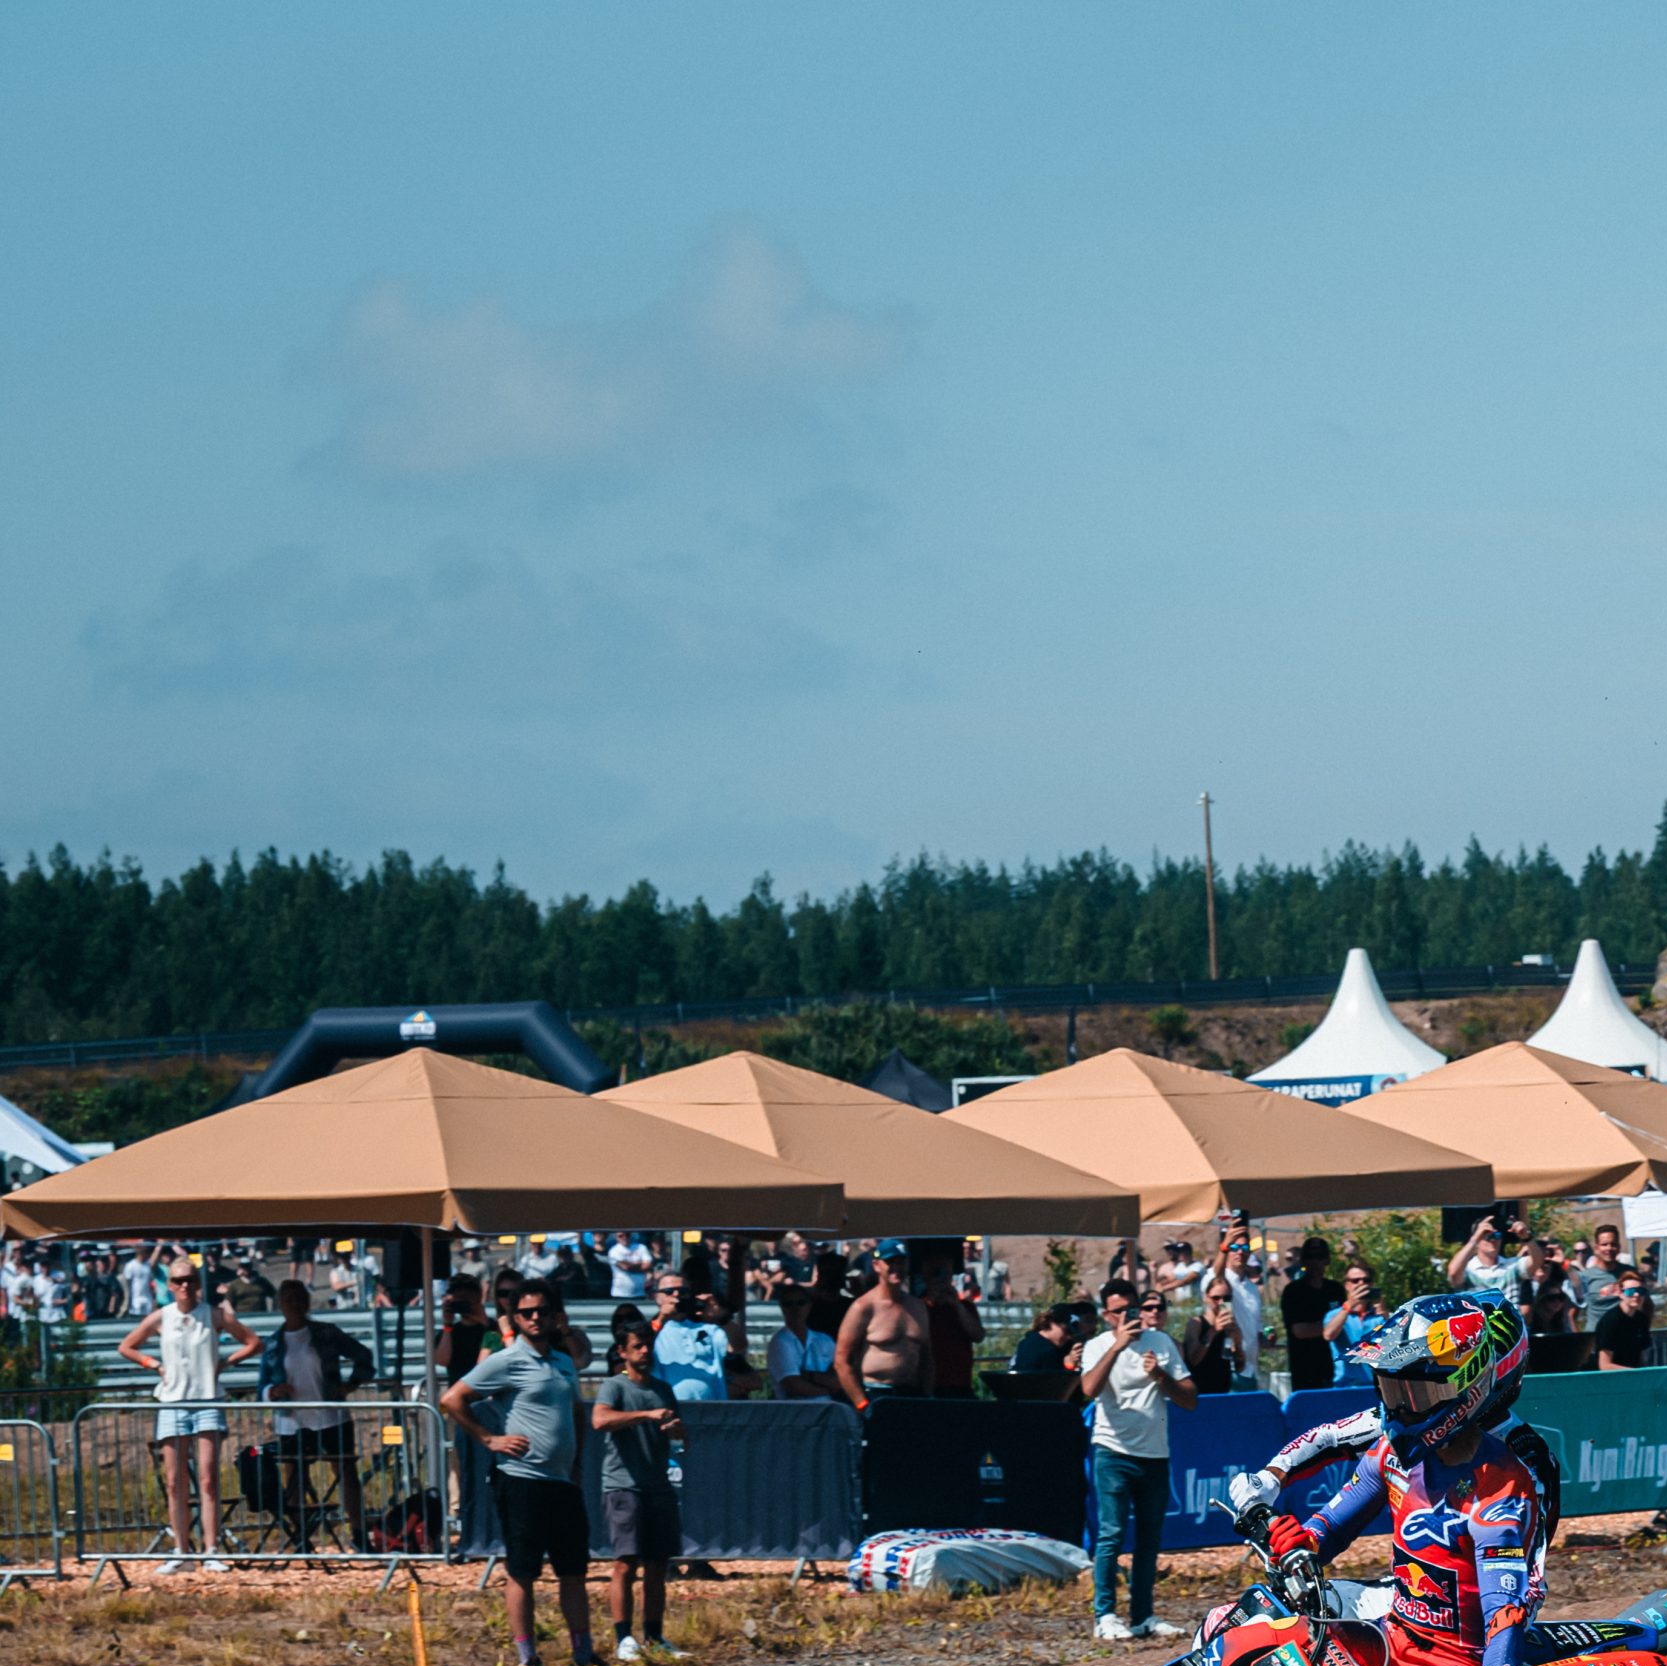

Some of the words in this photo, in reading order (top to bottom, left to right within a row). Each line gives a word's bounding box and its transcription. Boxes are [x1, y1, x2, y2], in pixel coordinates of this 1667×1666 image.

[1388, 1345, 1421, 1360] AIROH
[1422, 1413, 1458, 1447] Red
[1454, 1386, 1483, 1422] Bull
[1416, 1600, 1454, 1628] Bull
